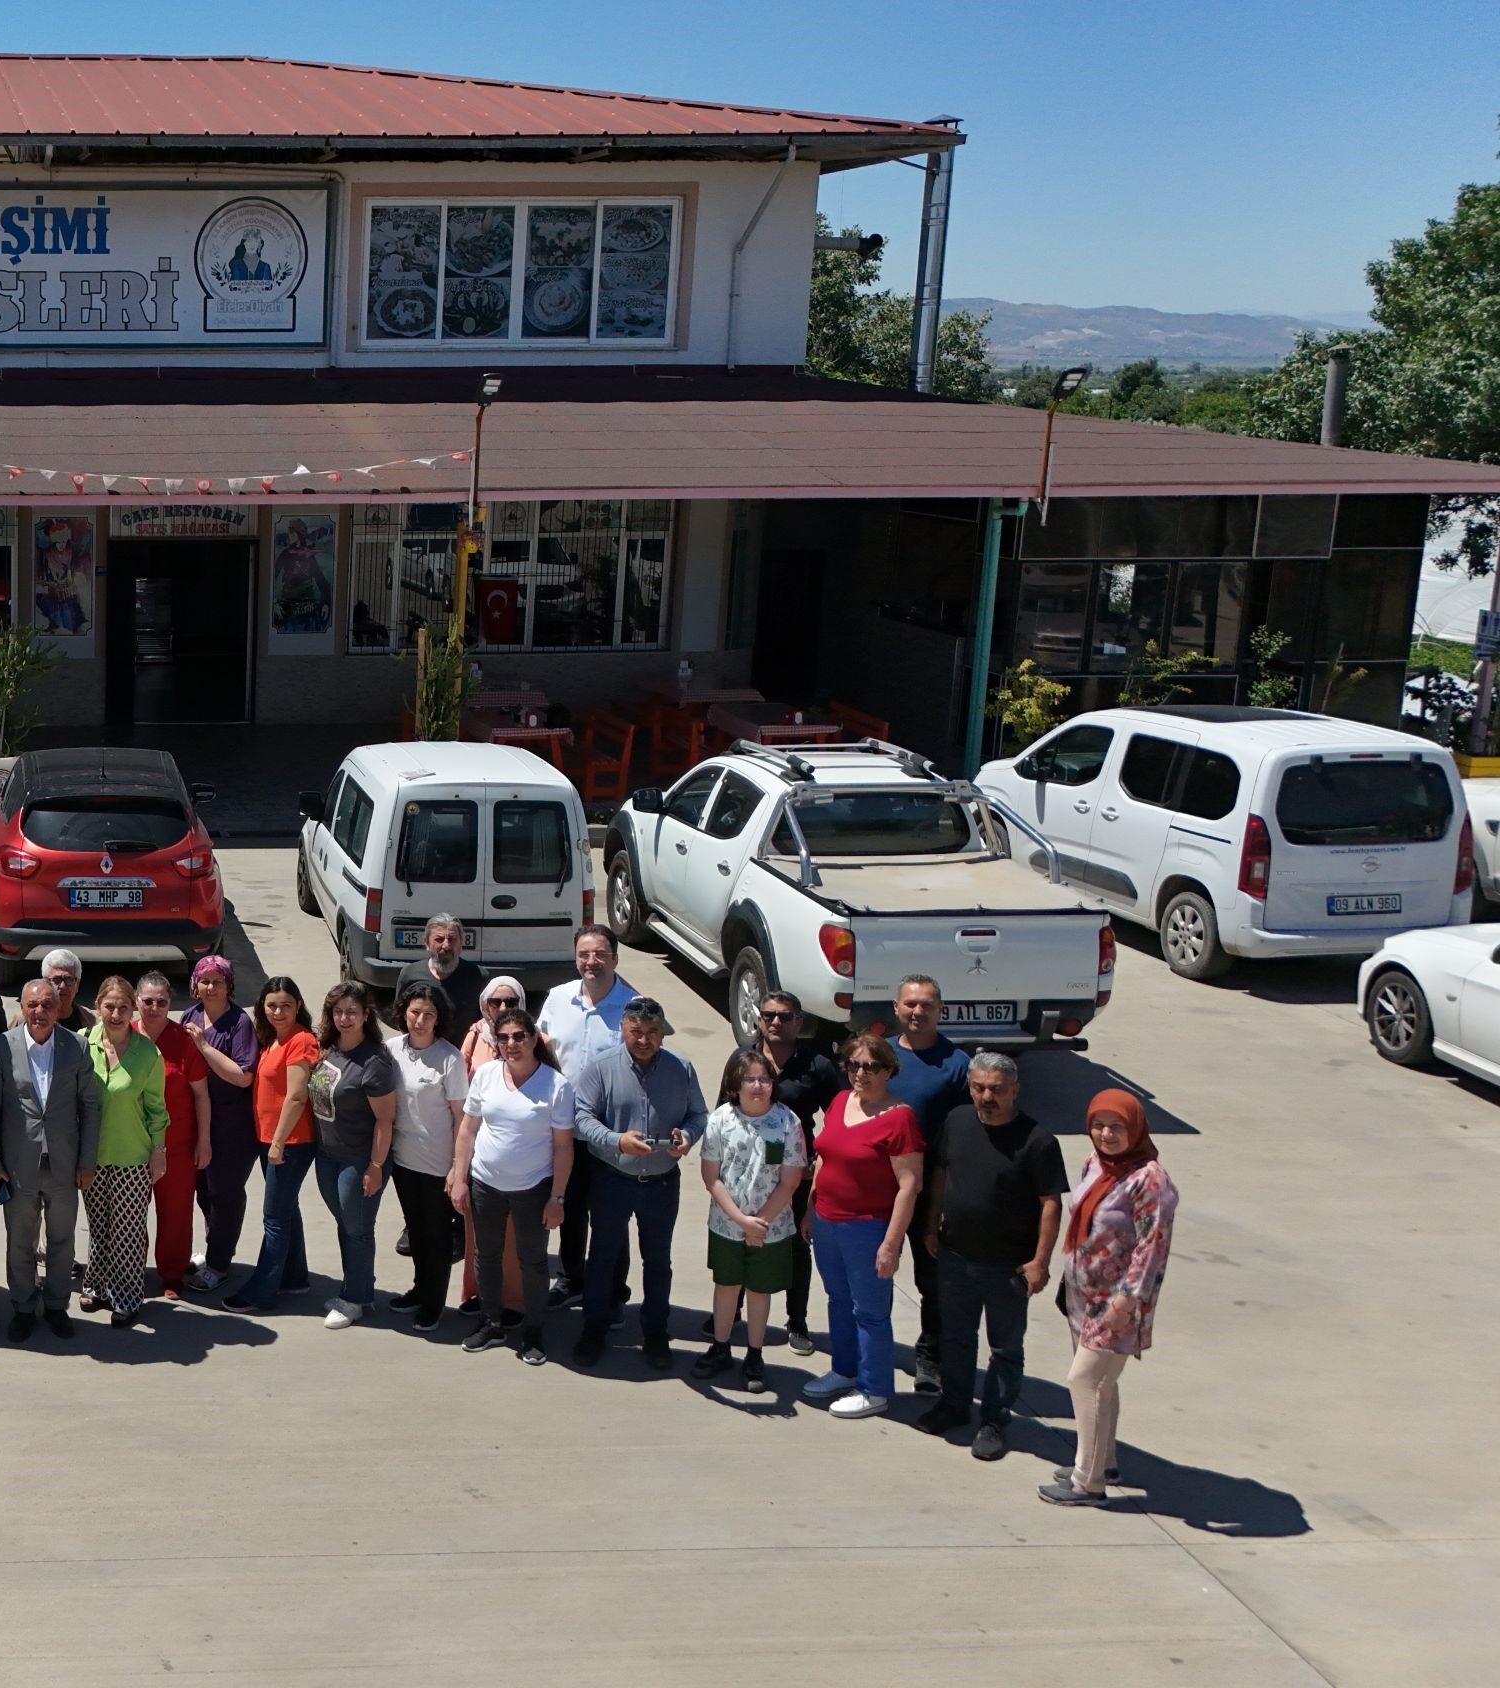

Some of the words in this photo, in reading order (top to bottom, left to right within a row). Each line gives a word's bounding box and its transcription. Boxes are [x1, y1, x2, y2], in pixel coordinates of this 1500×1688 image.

[121, 505, 160, 526] CAFE
[163, 504, 246, 526] RESTORAN
[76, 890, 90, 903] 43
[99, 890, 119, 903] MHP
[128, 890, 142, 903] 98
[1335, 899, 1349, 912] 09
[1354, 898, 1374, 911] ALN
[1378, 897, 1398, 910] 960
[404, 933, 418, 944] 35
[957, 1005, 981, 1020] ATL
[986, 1006, 1011, 1020] 867
